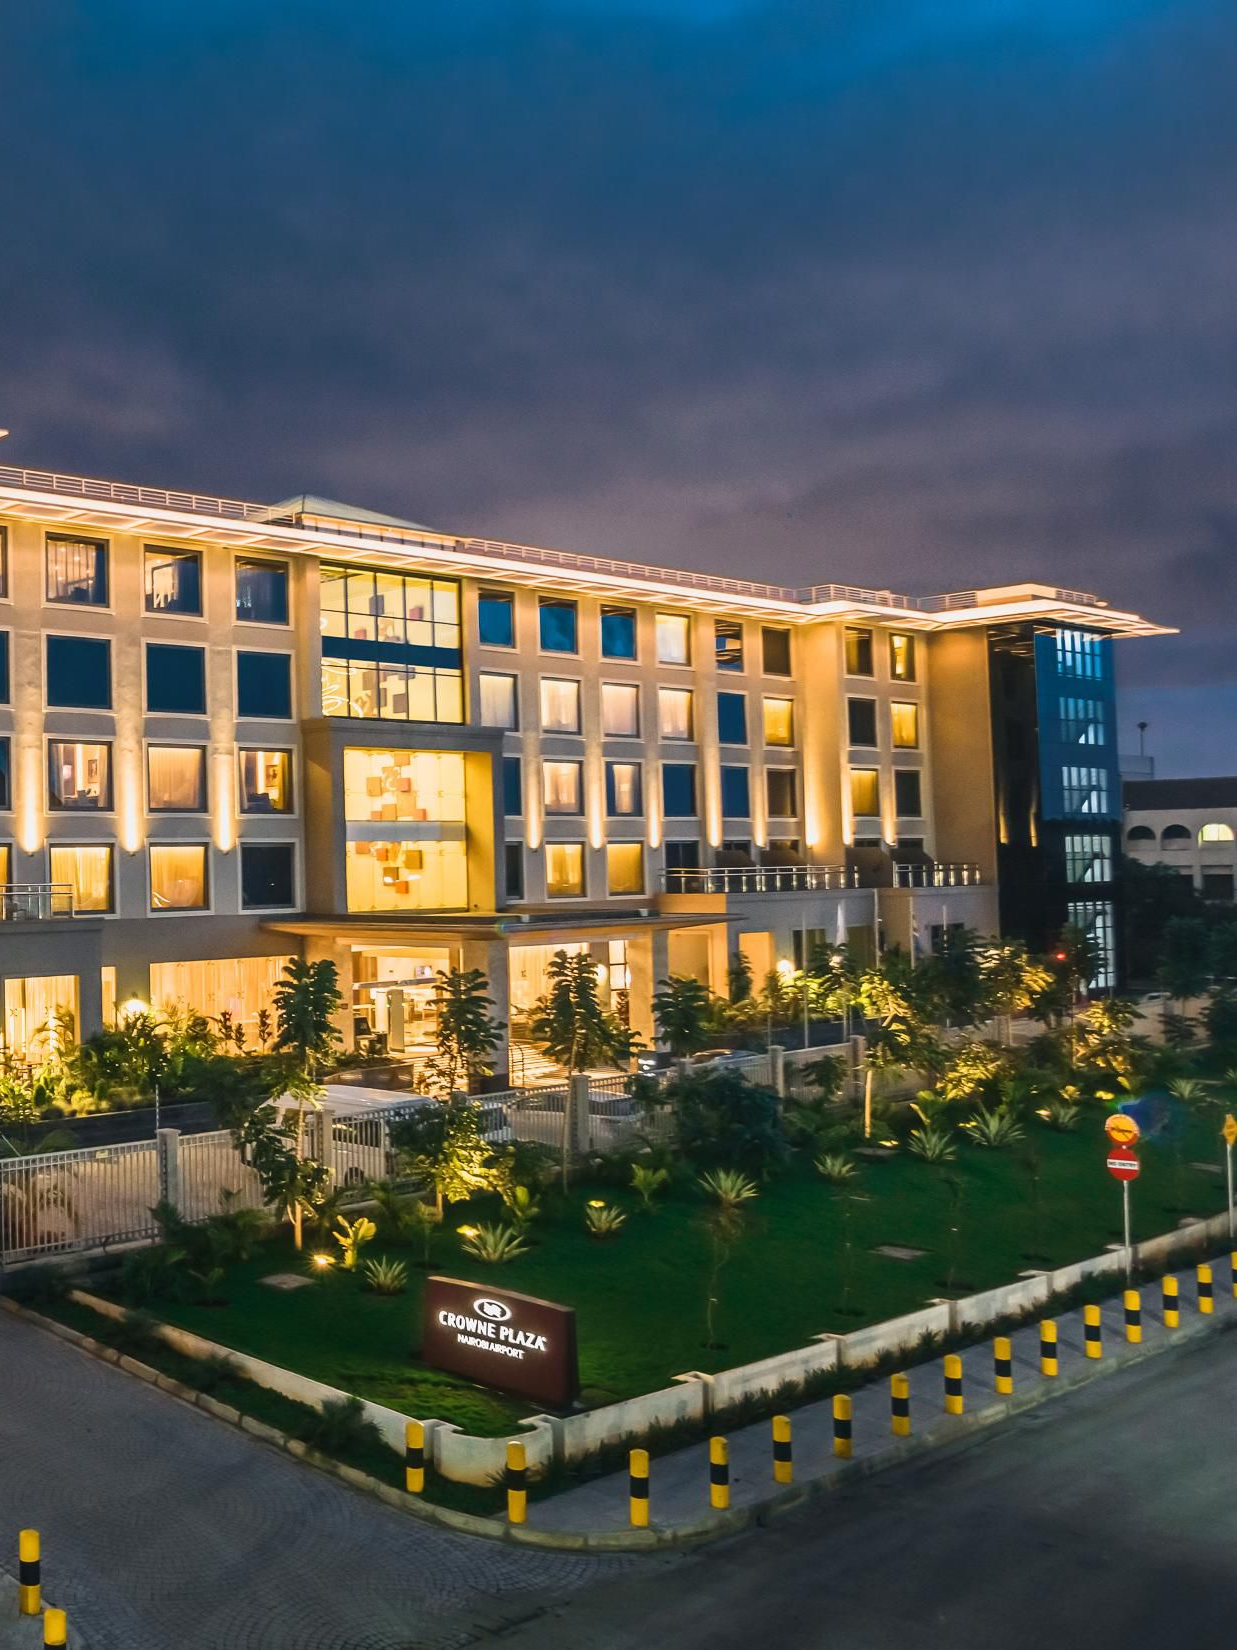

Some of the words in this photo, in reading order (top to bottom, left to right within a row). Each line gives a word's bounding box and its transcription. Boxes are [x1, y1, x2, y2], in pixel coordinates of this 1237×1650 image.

[438, 1311, 496, 1338] CROWNE
[499, 1326, 546, 1351] PLAZA
[457, 1333, 489, 1350] NAIROBI
[489, 1342, 525, 1359] AIRPORT
